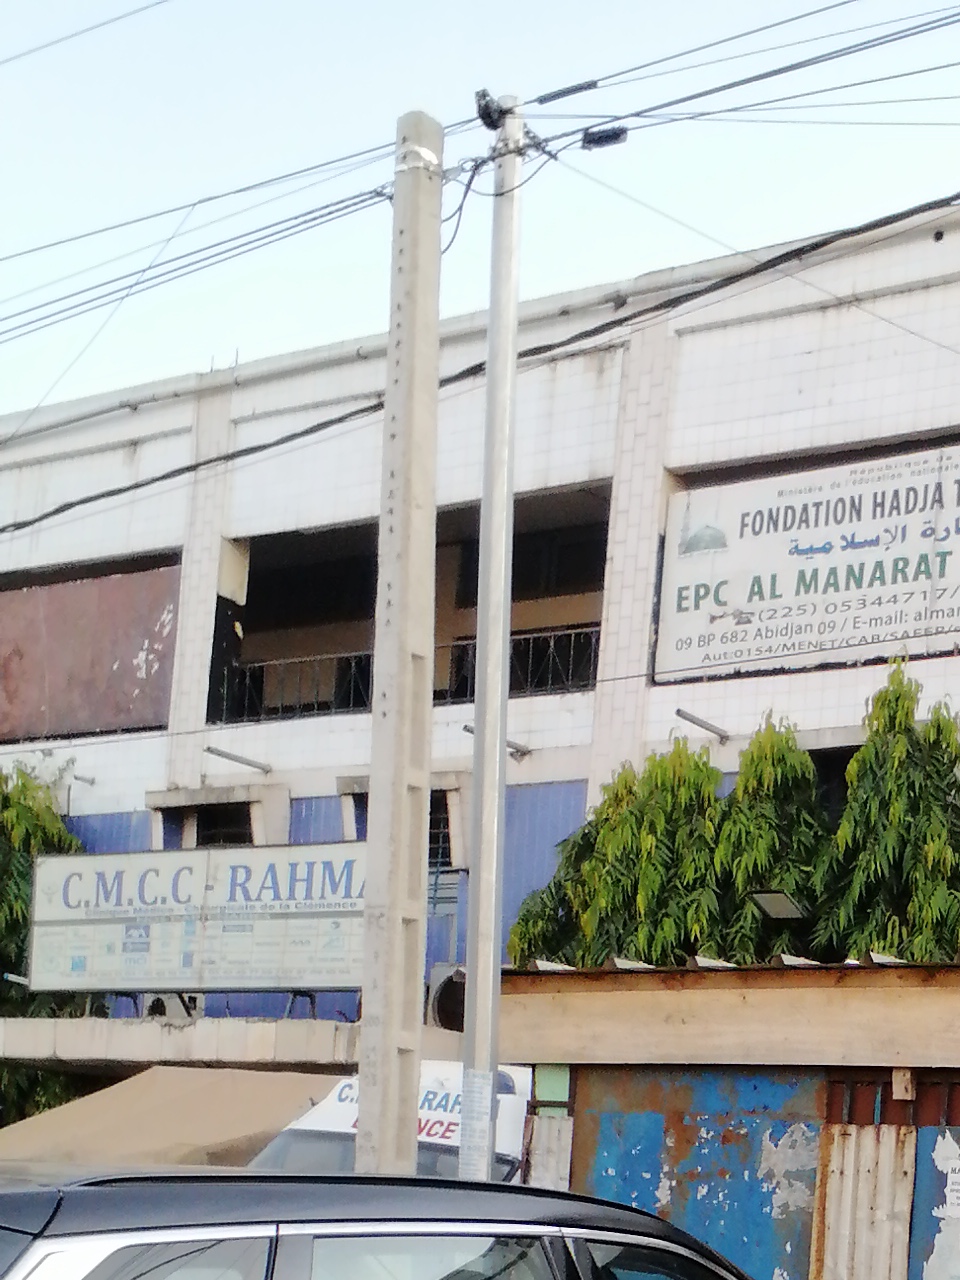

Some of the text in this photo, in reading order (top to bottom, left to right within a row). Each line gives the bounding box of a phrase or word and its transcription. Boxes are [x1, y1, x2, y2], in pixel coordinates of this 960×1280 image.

[739, 493, 863, 539] FONDATION
[872, 481, 945, 520] HADJA
[788, 524, 907, 560] الإسلامية
[676, 579, 729, 613] EPC
[747, 573, 783, 603] AL
[794, 550, 953, 597] MANARAT
[758, 603, 817, 623] (225)
[675, 638, 693, 652] 09
[697, 633, 716, 648] BP
[720, 629, 748, 645] 682
[753, 621, 814, 642] Abidjan
[818, 620, 837, 636] 09
[62, 866, 193, 909] C.M.C.C
